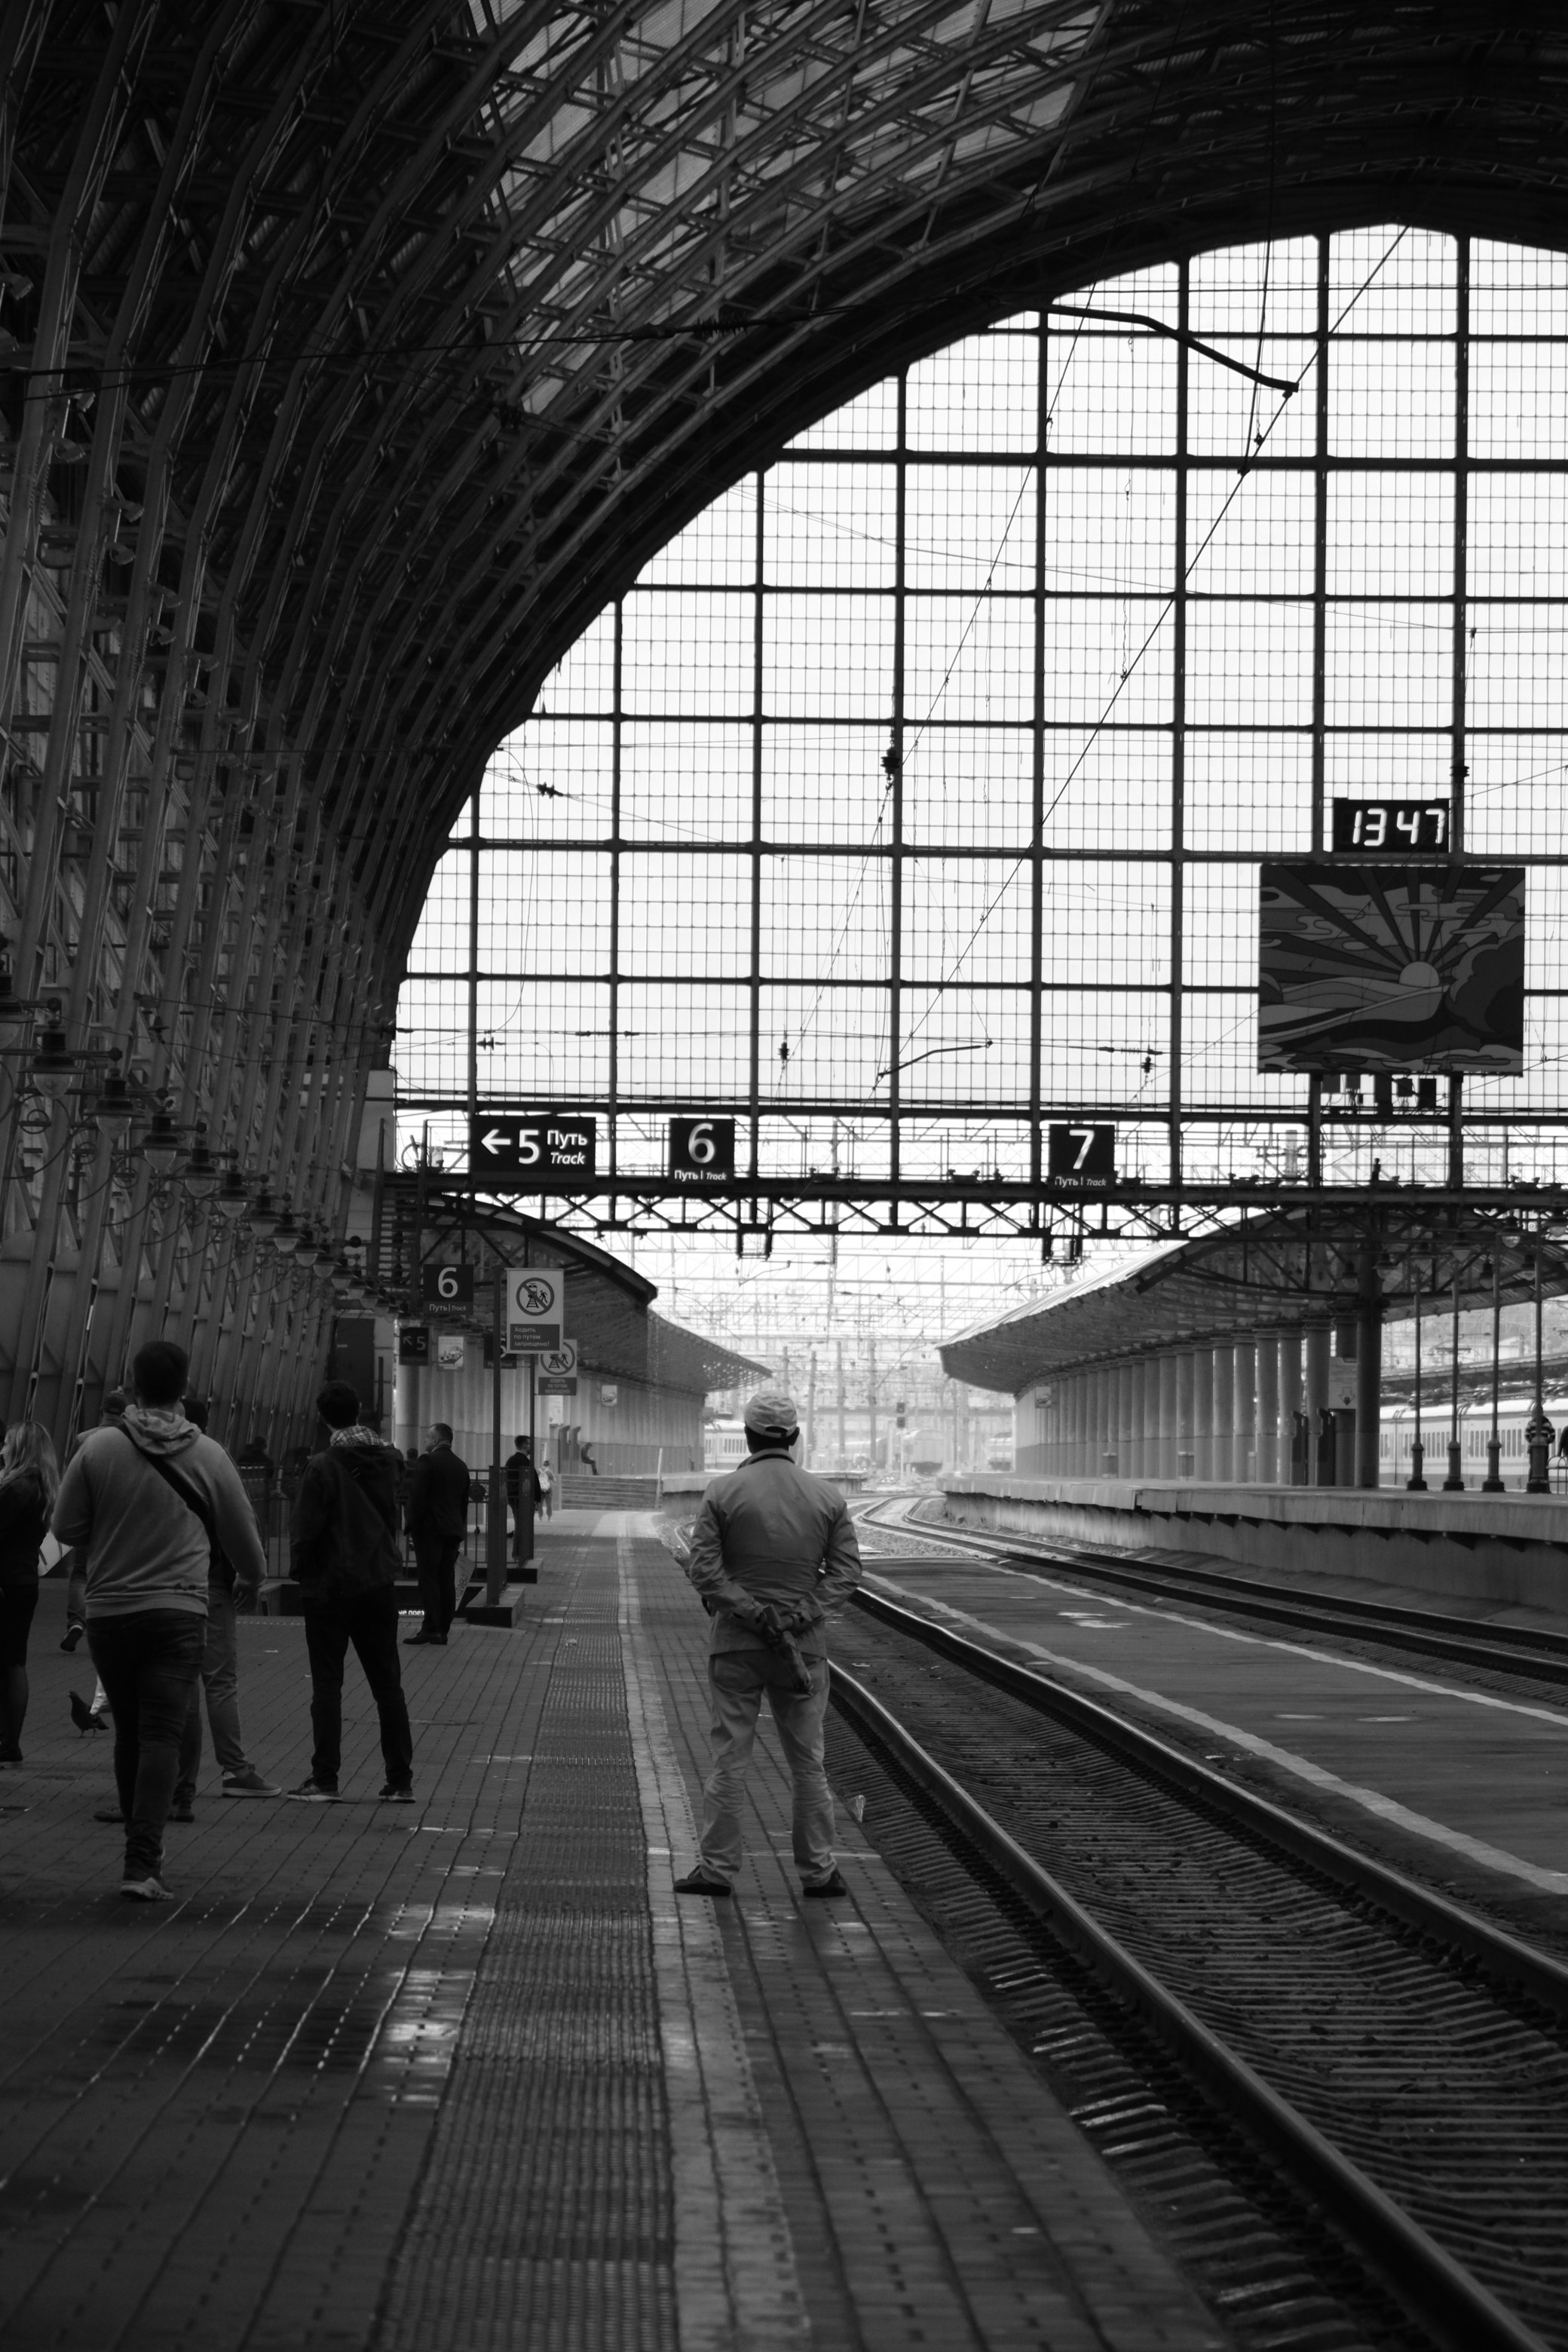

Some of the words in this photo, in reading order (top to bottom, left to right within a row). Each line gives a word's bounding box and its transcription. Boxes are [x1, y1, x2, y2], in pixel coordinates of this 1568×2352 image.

[518, 1129, 541, 1165] 5
[547, 1129, 588, 1150] Путь
[688, 1122, 715, 1163] 6
[550, 1151, 586, 1165] Track
[1069, 1129, 1095, 1170] 7
[674, 1169, 699, 1182] Путь
[706, 1171, 727, 1181] Track
[1054, 1175, 1079, 1188] Путь
[1086, 1178, 1107, 1187] Track
[437, 1266, 458, 1299] 6
[429, 1303, 448, 1313] Путь
[417, 1335, 427, 1351] 5
